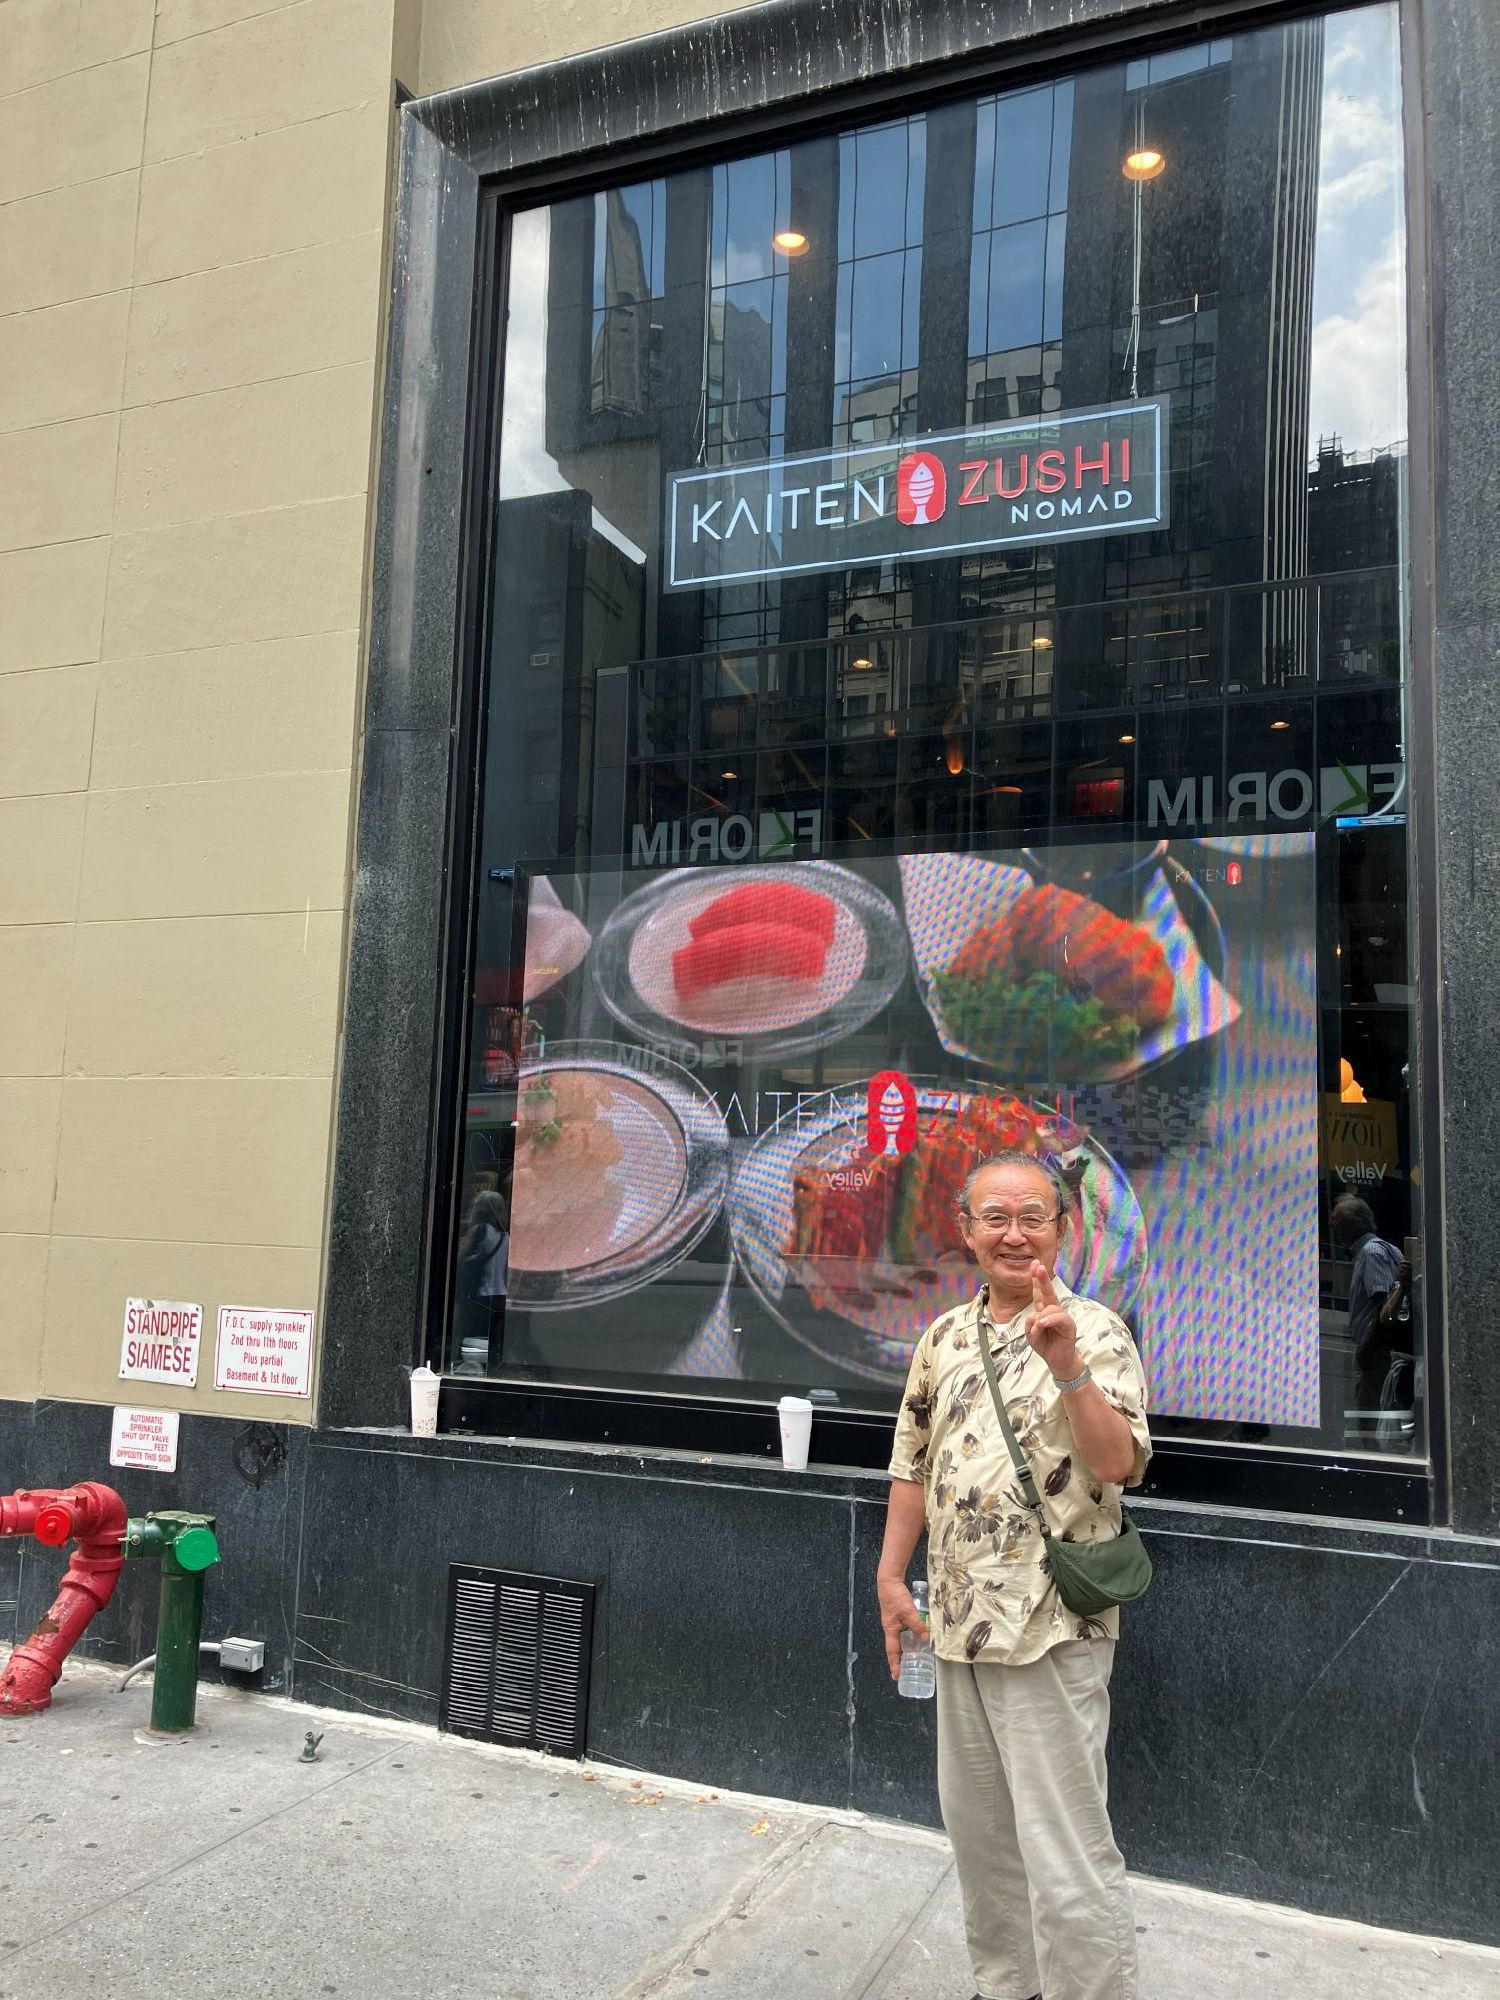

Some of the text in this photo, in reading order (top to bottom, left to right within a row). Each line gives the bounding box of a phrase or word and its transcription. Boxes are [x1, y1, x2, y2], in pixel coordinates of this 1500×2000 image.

[691, 438, 1130, 544] KAITEN ZUSHI
[1011, 489, 1133, 524] NOMAD
[1175, 867, 1226, 883] KTEN
[127, 1308, 199, 1339] STANDPIPE
[250, 1320, 273, 1333] supply
[275, 1321, 306, 1333] sprinkler
[231, 1334, 244, 1346] 2nd
[246, 1335, 260, 1347] thru
[278, 1337, 298, 1351] floors
[127, 1341, 192, 1374] SIAMESE
[243, 1352, 283, 1367] Plus partial
[226, 1368, 298, 1385] Basement & 1st floor
[130, 1414, 163, 1425] AUTOMATIC
[130, 1423, 162, 1434] SPRINKLER
[121, 1432, 169, 1443] SHUT OFF VALVE
[154, 1443, 168, 1452] FEET
[116, 1450, 171, 1463] OPPOSITE THIS SIGN
